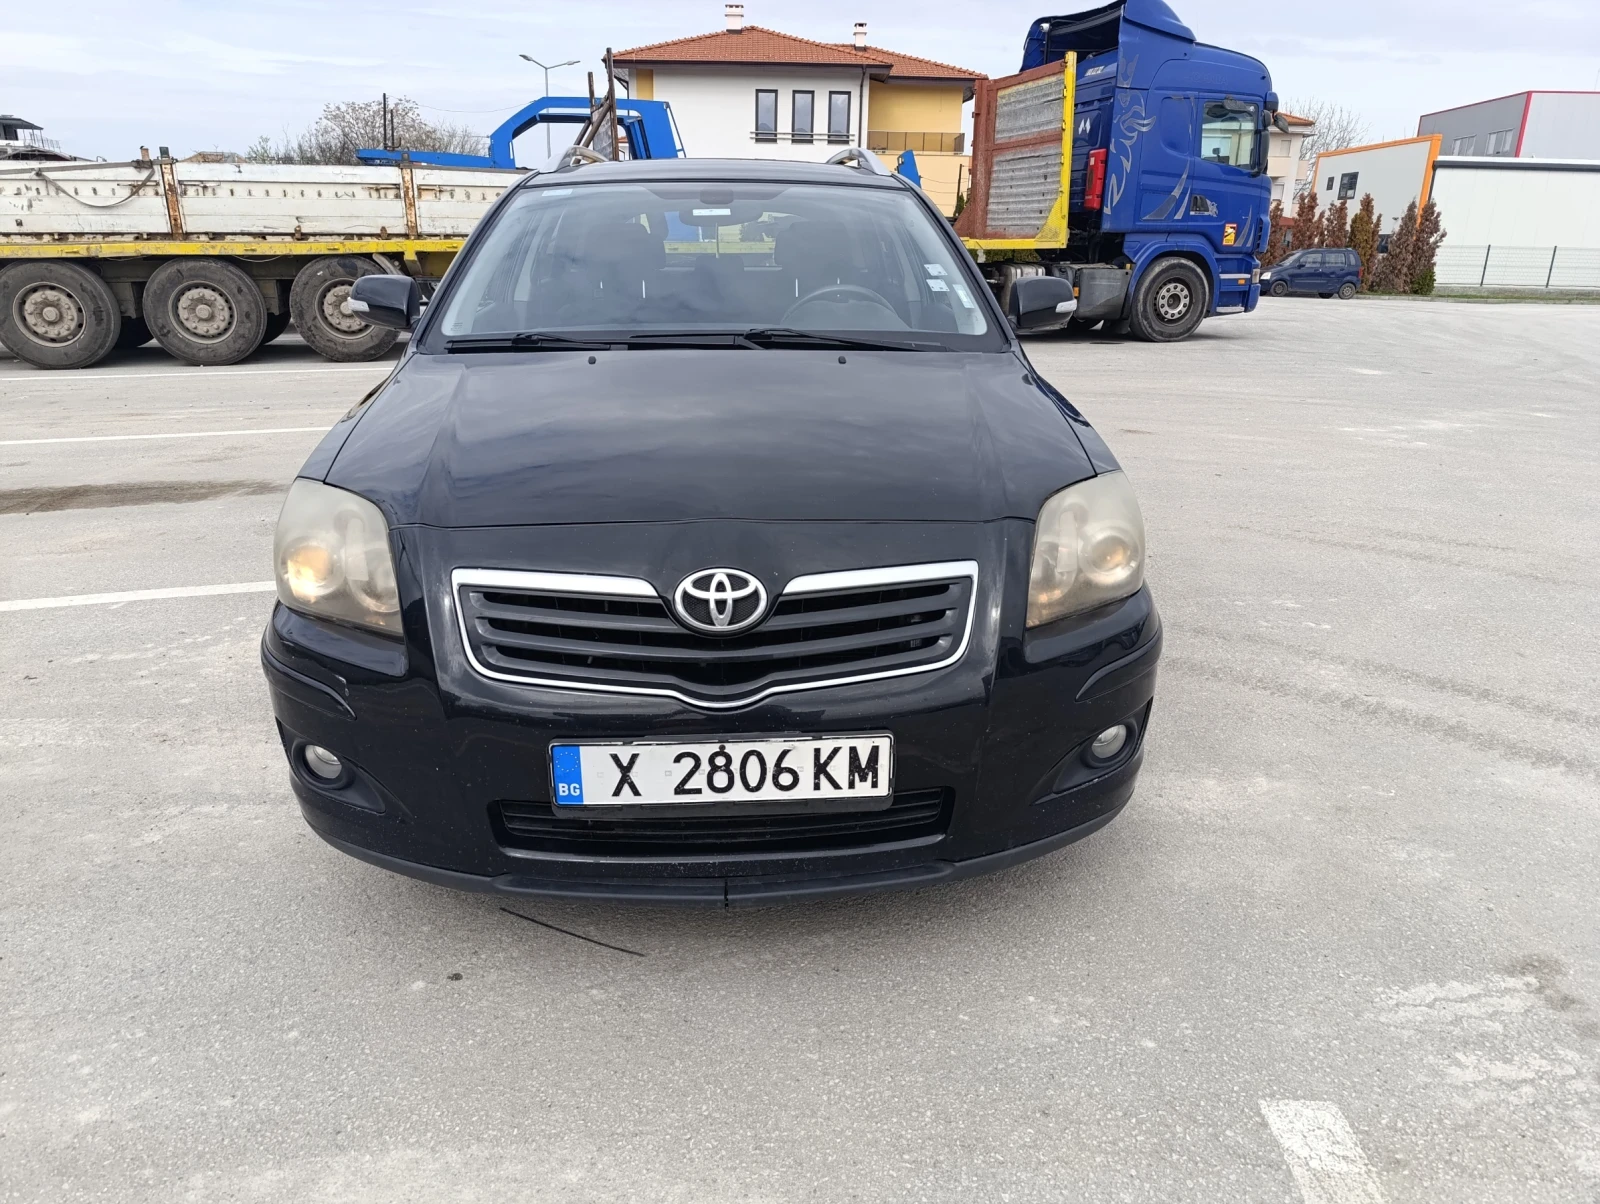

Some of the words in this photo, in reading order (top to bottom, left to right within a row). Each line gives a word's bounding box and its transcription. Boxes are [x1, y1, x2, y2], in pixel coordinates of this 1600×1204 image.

[609, 753, 642, 797] X
[673, 749, 800, 795] 2806
[812, 745, 880, 791] KM
[558, 783, 580, 796] BG
